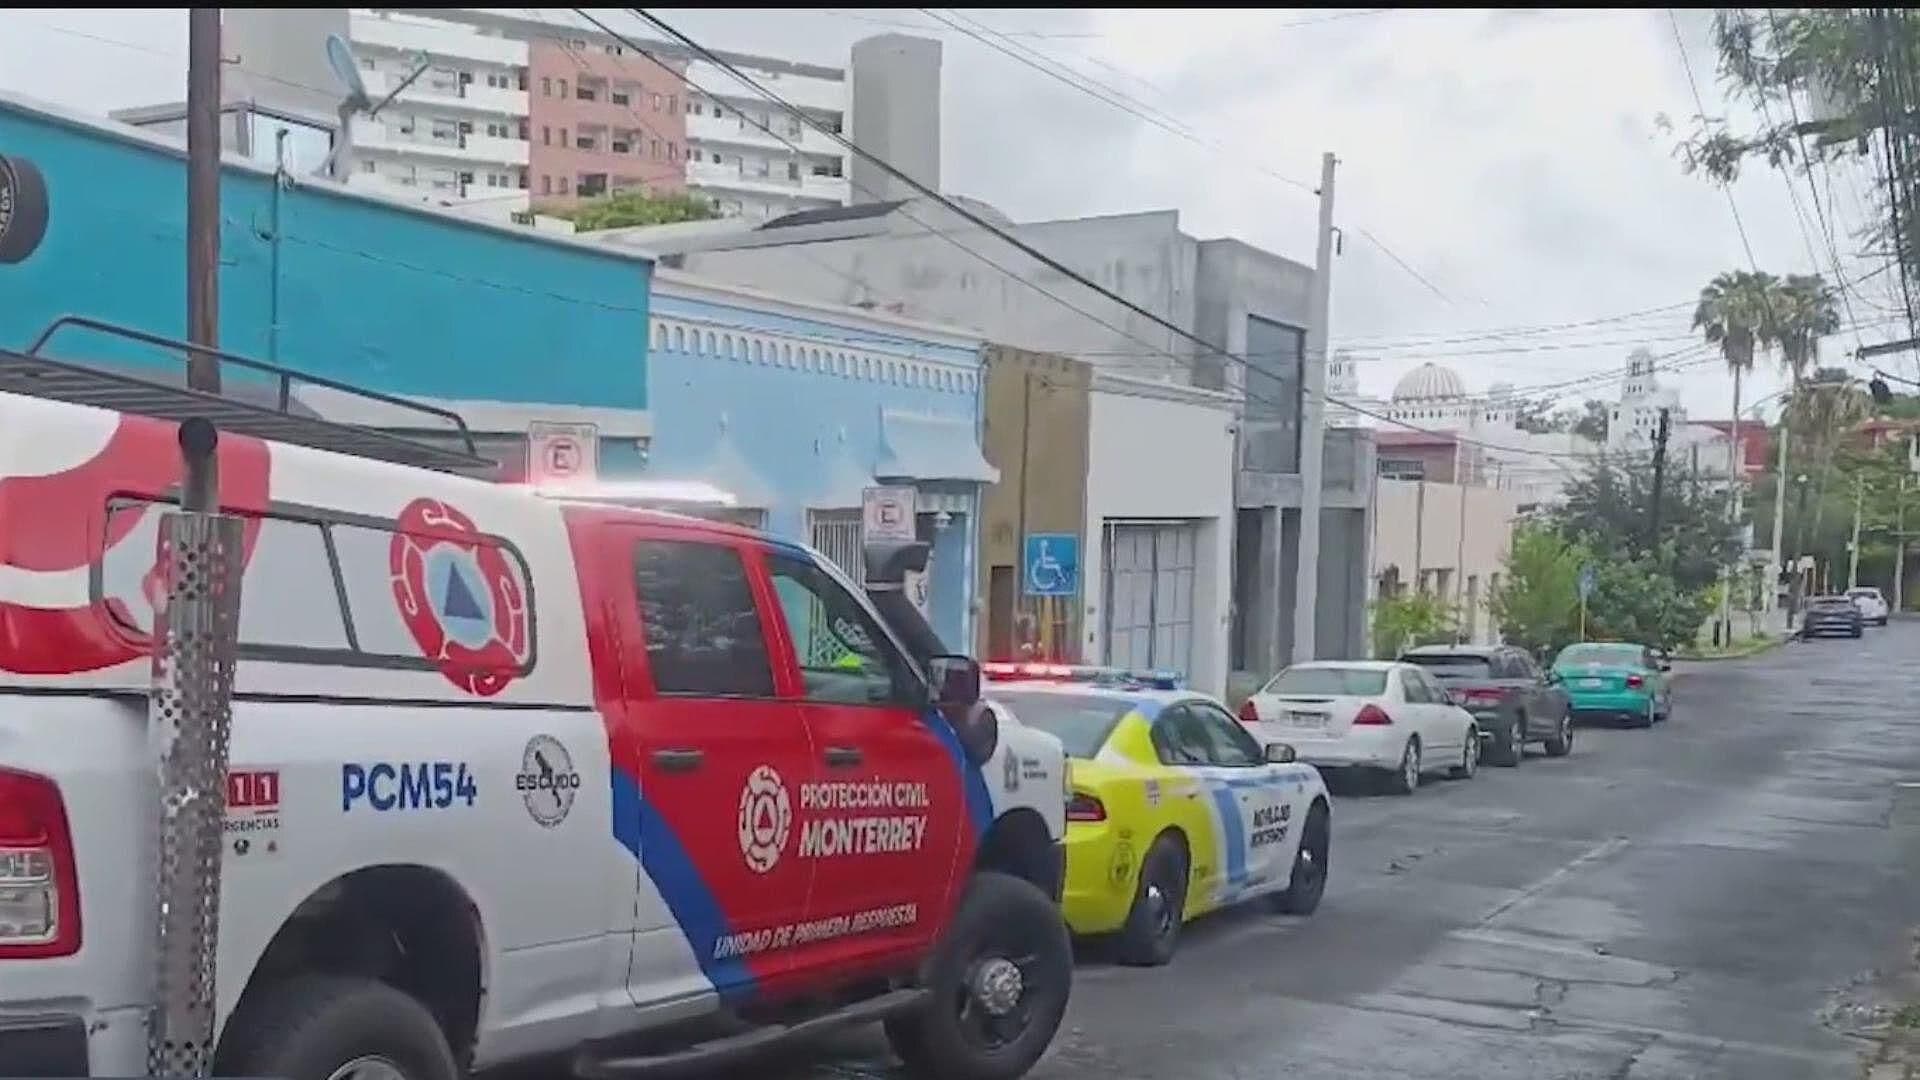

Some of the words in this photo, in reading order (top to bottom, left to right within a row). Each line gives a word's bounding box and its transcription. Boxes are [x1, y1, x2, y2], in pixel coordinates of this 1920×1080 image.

[342, 762, 477, 812] PCM54
[800, 775, 893, 810] PROTECCIÓN
[894, 782, 930, 808] CIVIL
[799, 815, 928, 857] MONTERREY
